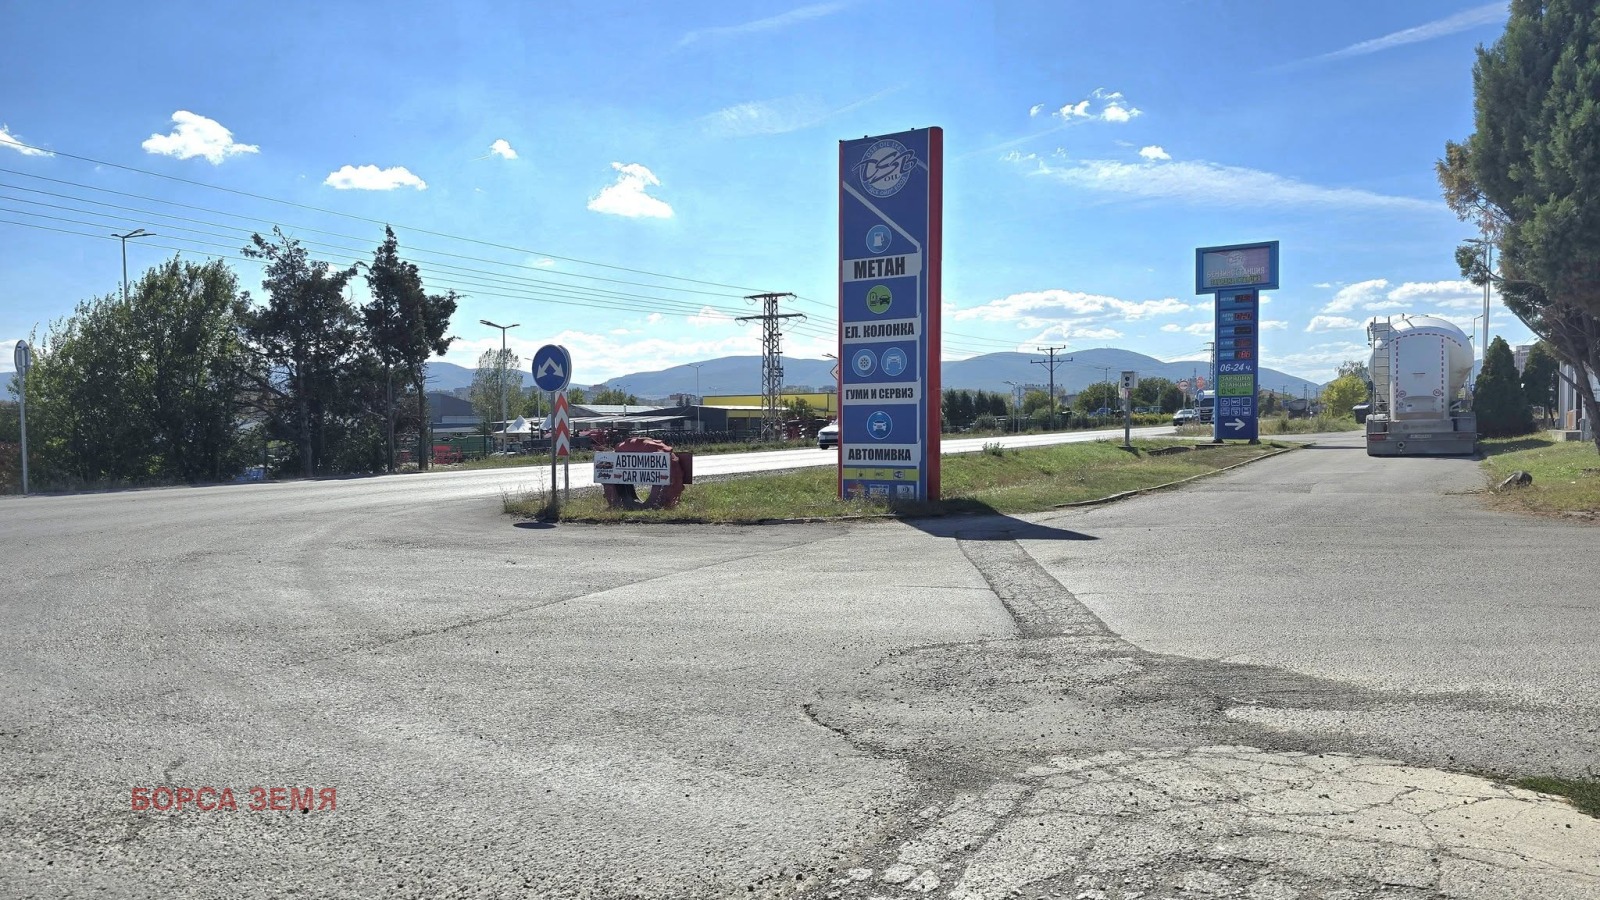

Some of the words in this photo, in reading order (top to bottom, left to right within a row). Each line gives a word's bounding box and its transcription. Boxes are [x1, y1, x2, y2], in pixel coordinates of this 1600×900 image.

[854, 256, 905, 279] МЕТАН
[845, 326, 861, 339] ЕЛ.
[863, 322, 914, 337] КОЛОНКА
[1220, 363, 1244, 372] 06-24
[845, 388, 869, 400] ГУМИ
[870, 388, 877, 399] И
[878, 387, 913, 399] СЕРВИЗ
[615, 454, 667, 468] АВТОМИВКА
[848, 448, 911, 461] АВТОМИВКА
[622, 470, 637, 482] CAR
[639, 470, 660, 483] WASH
